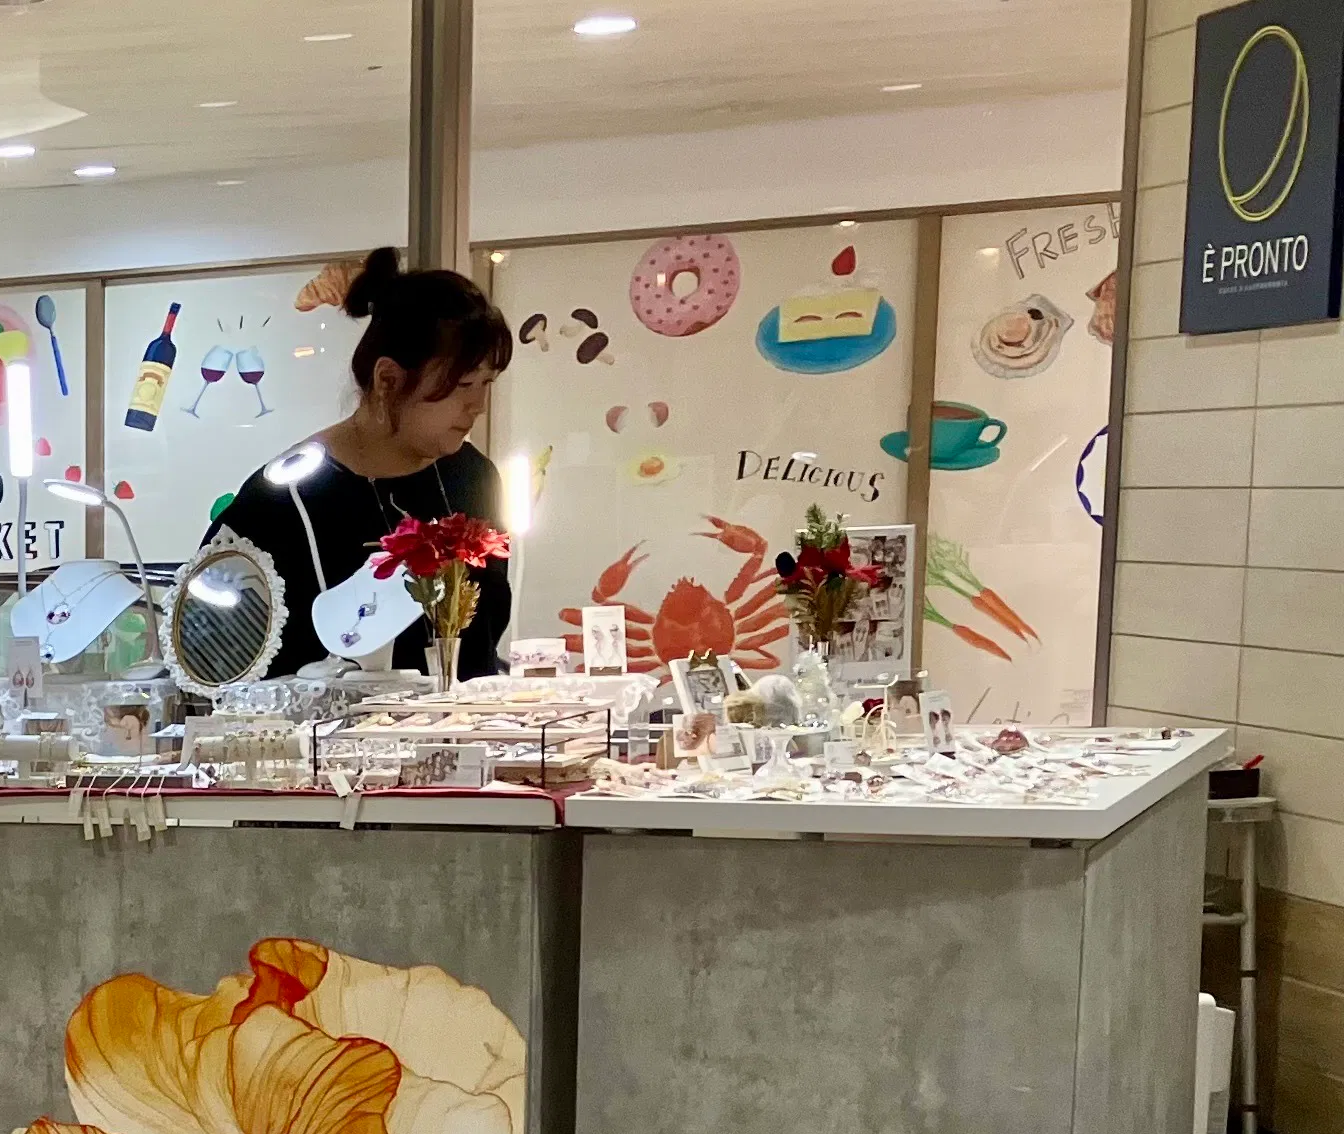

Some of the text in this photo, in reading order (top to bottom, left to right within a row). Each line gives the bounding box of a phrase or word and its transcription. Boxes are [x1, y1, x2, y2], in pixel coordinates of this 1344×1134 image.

[1202, 234, 1309, 284] È PRONTO
[735, 449, 885, 503] DELICIOUS
